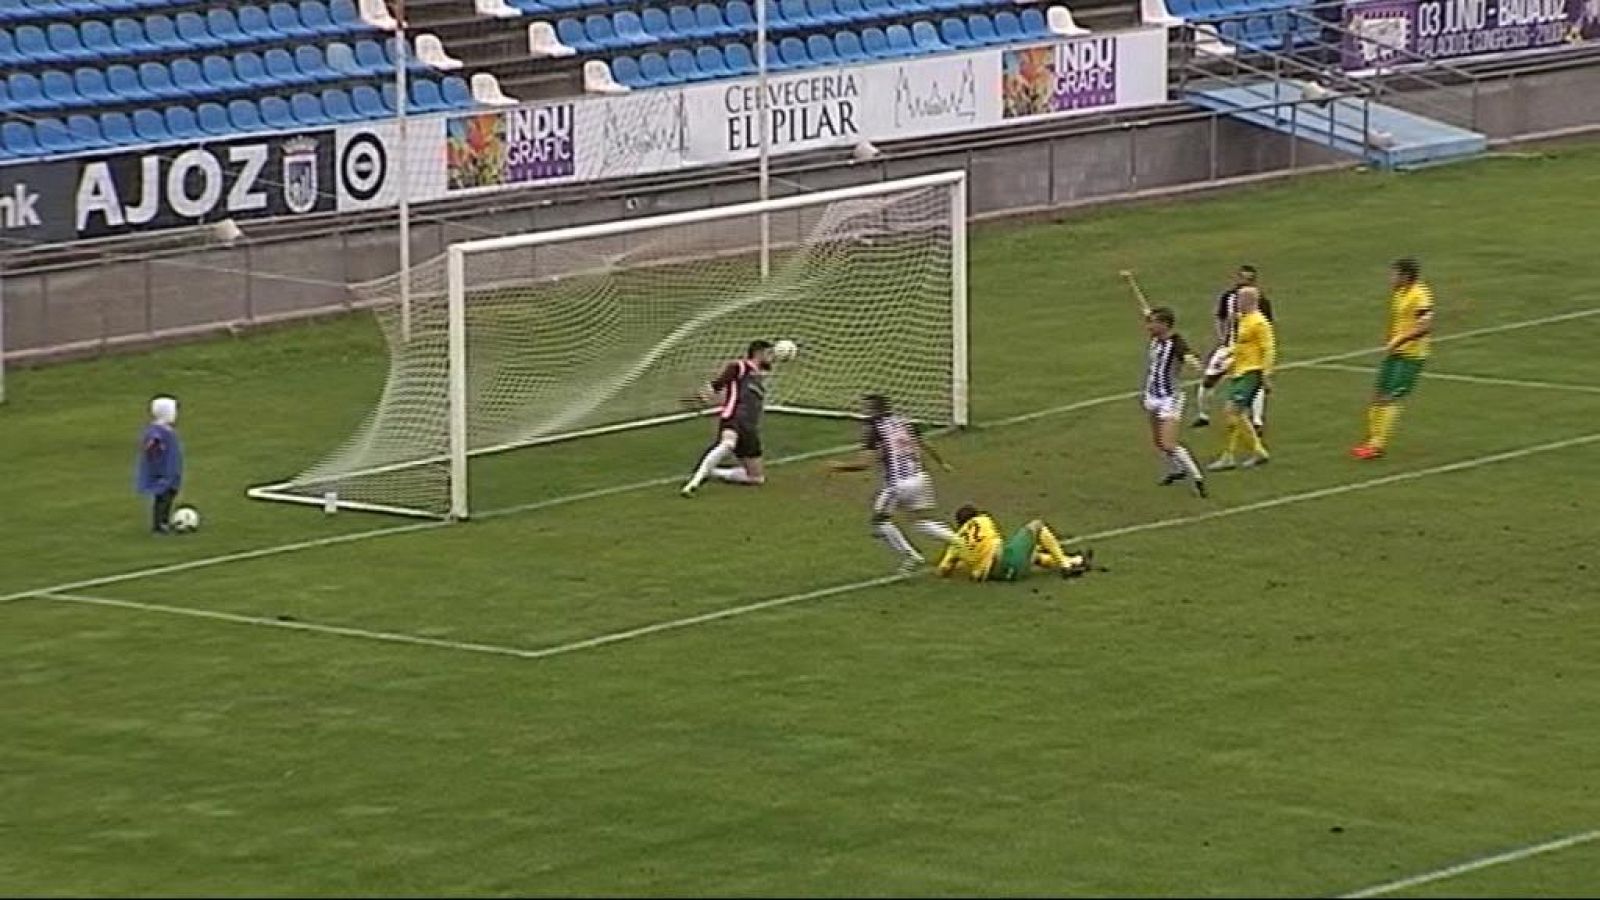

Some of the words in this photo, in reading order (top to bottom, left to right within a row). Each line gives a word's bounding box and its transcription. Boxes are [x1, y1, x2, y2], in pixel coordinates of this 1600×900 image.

[1418, 2, 1441, 36] 03
[1054, 37, 1113, 73] INDU
[506, 104, 570, 144] INDU
[728, 115, 760, 151] EL
[771, 100, 859, 145] PILAR
[76, 143, 269, 232] AJOZ
